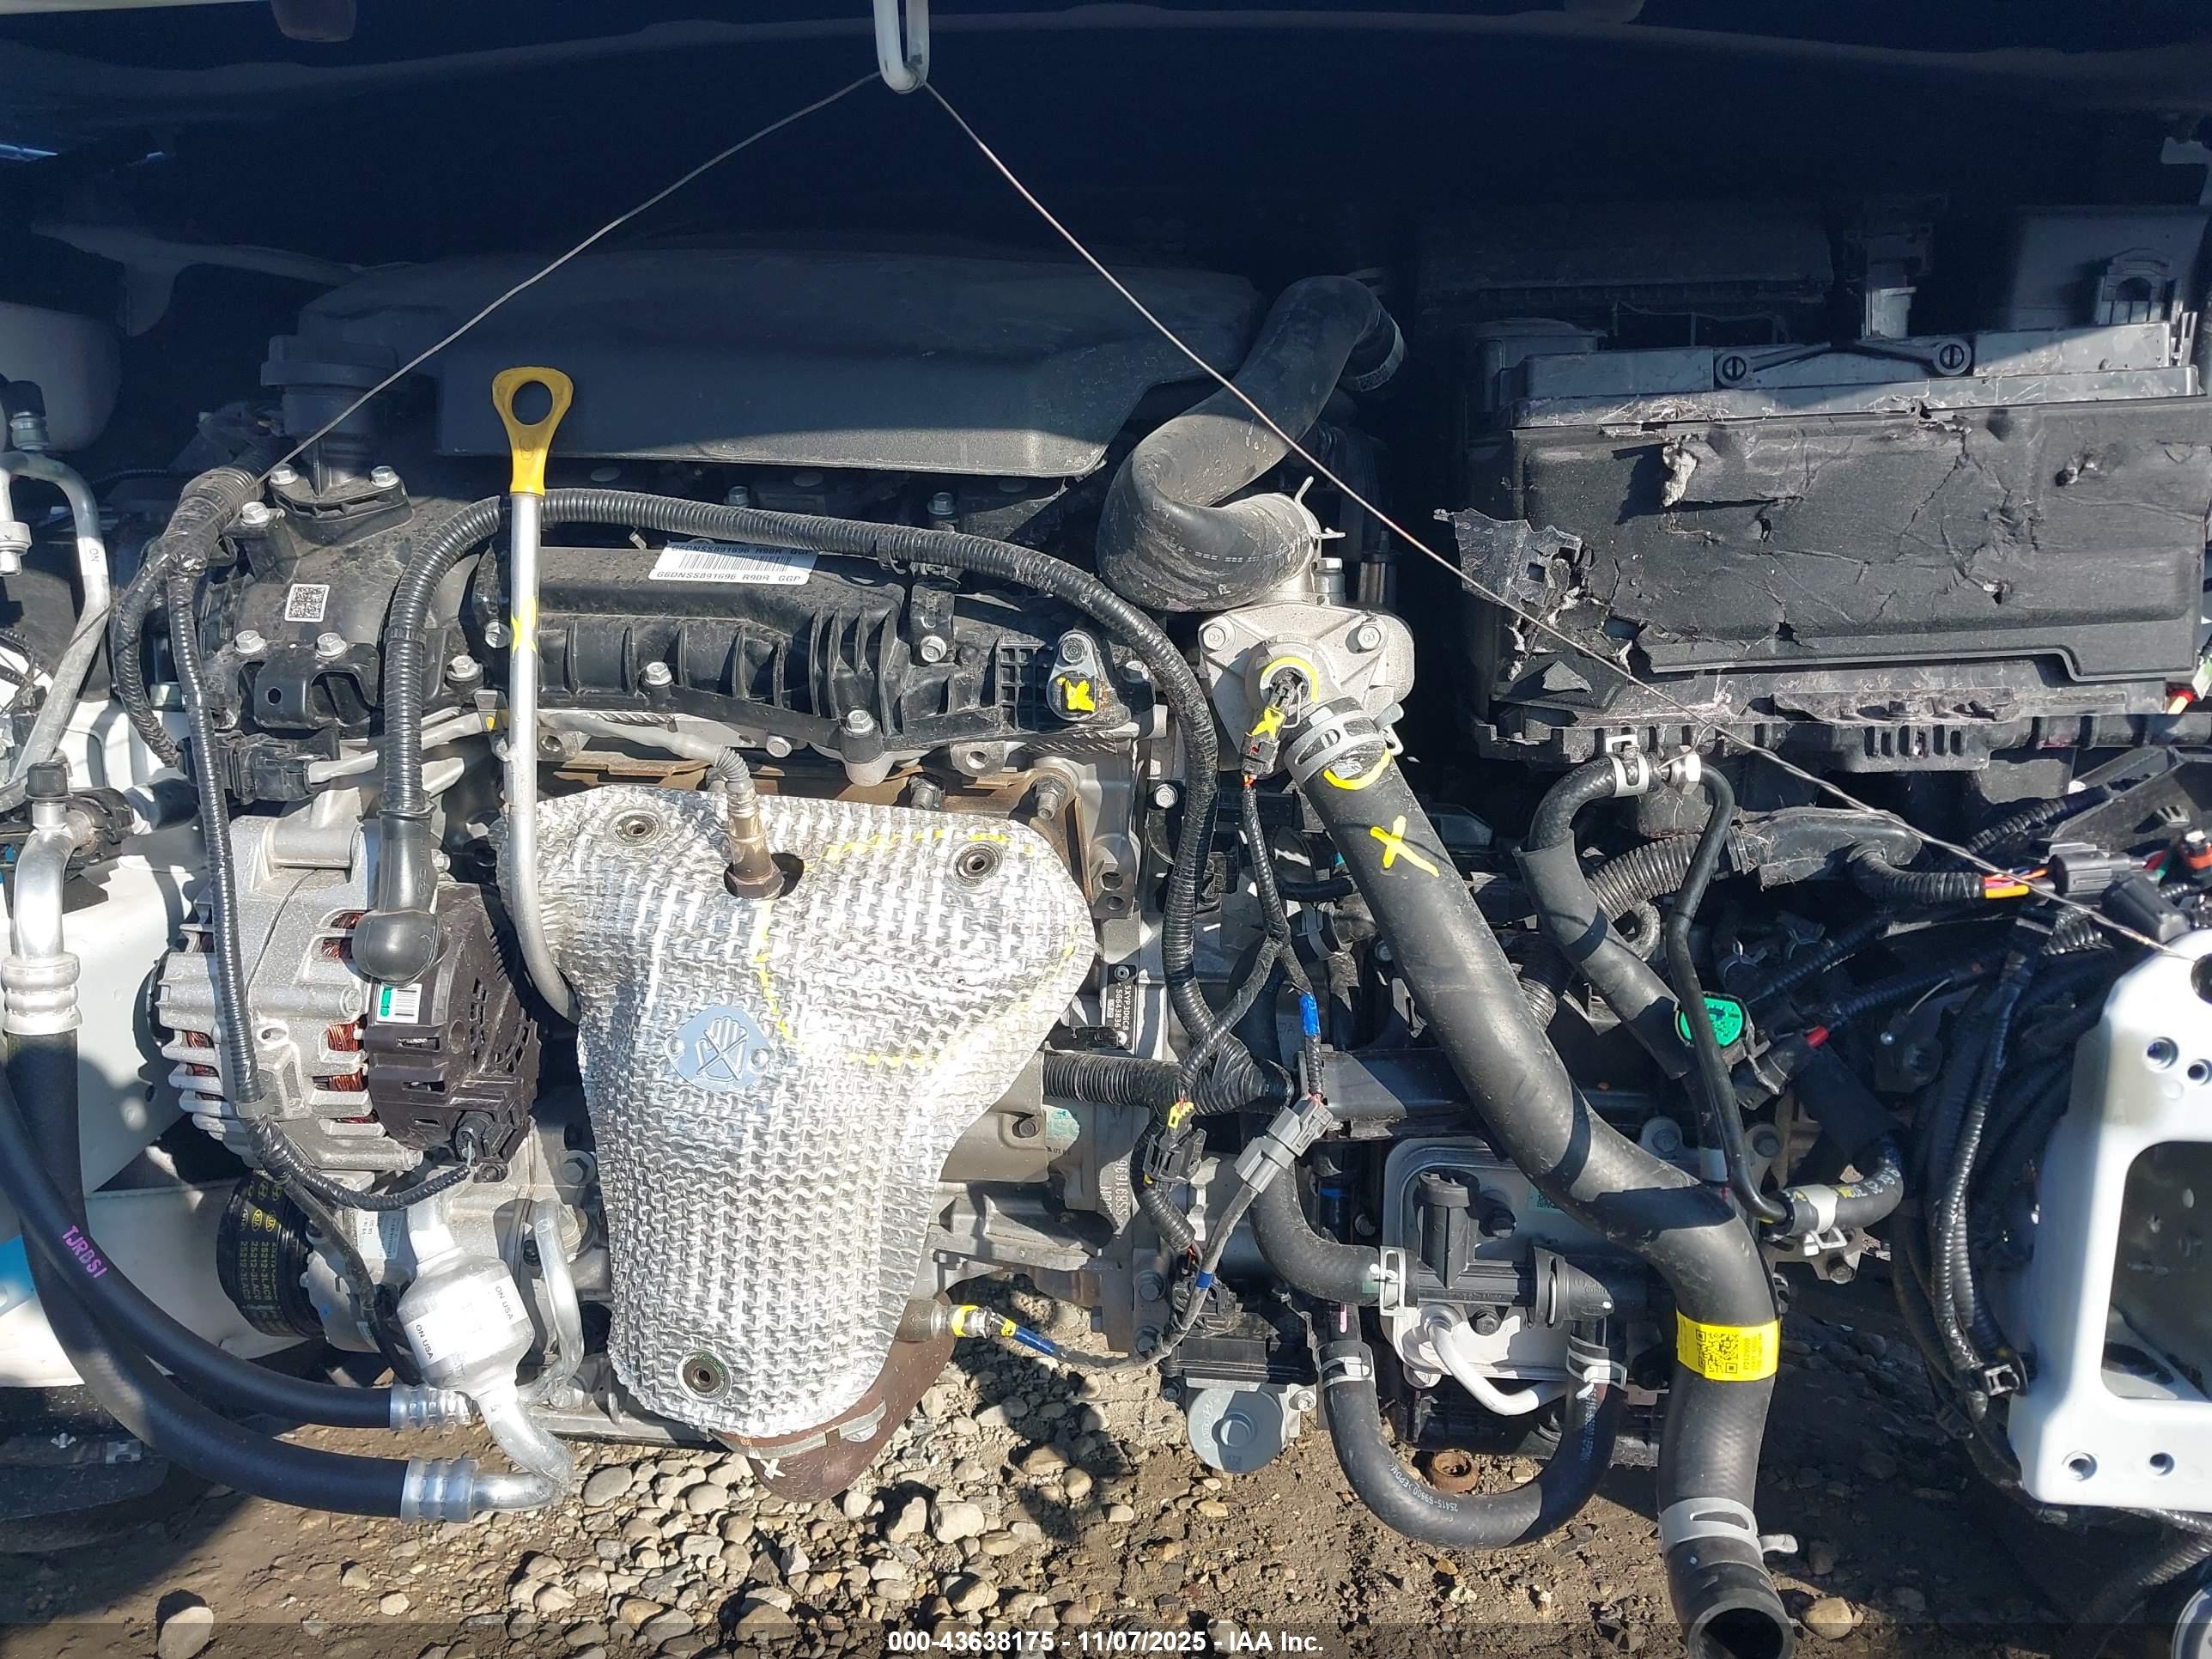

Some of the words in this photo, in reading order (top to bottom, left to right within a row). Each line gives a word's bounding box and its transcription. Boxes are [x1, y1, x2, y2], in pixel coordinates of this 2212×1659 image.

[1122, 985, 1132, 1031] 5XYP3DGC8
[1115, 1159, 1128, 1216] SS891696
[422, 1340, 434, 1360] USA
